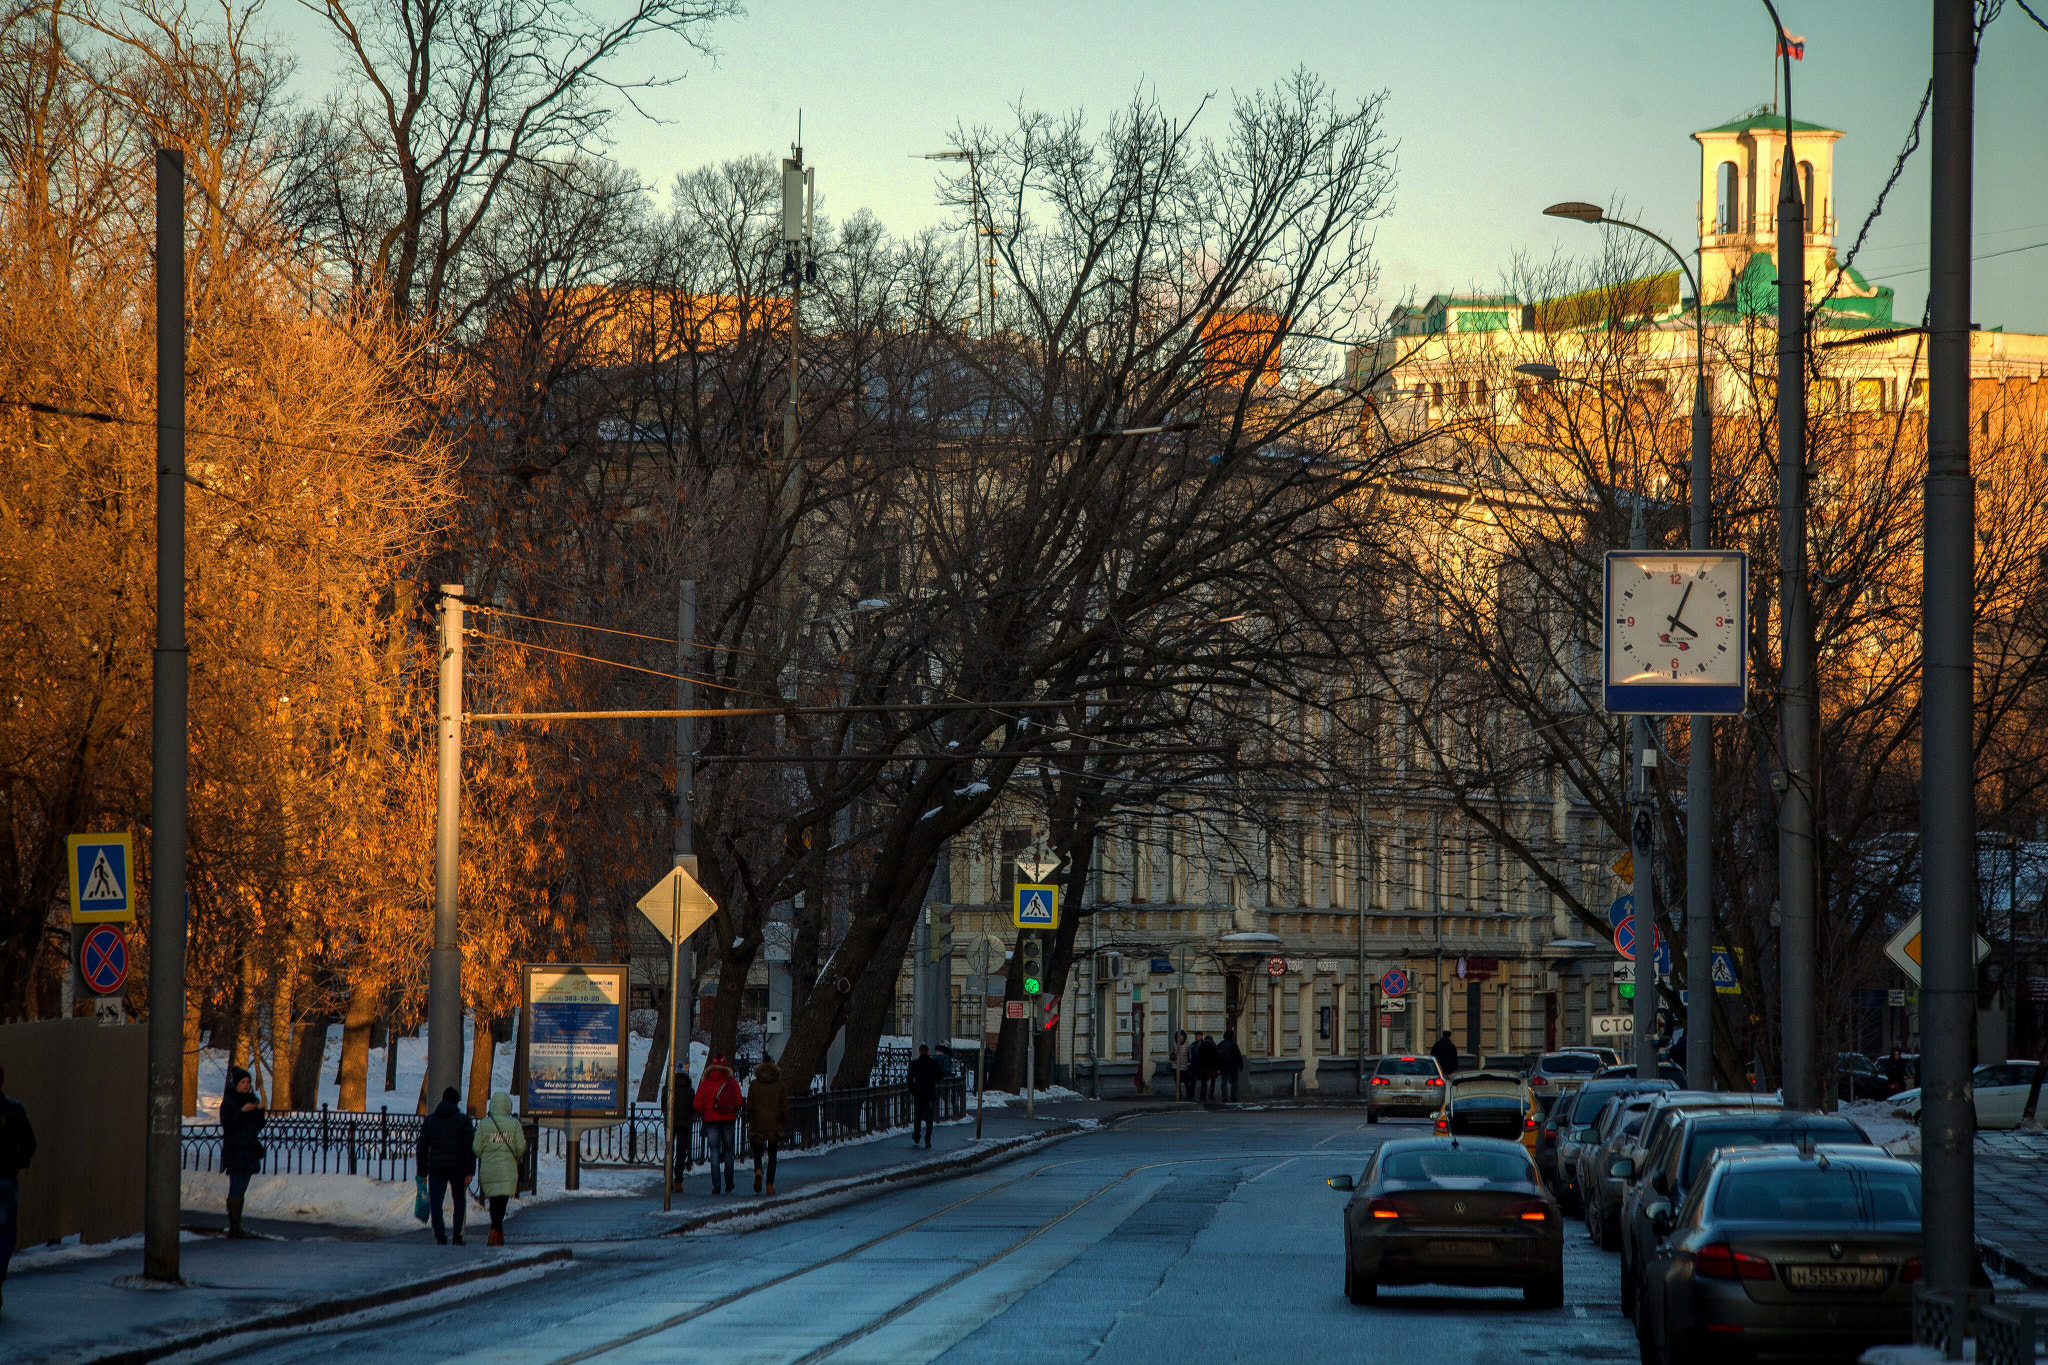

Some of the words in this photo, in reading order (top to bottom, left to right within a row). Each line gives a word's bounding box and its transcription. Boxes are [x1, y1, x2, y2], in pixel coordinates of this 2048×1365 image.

[1669, 574, 1681, 585] 12
[1627, 616, 1635, 627] 9
[1715, 616, 1723, 627] 3
[1671, 658, 1679, 669] 6
